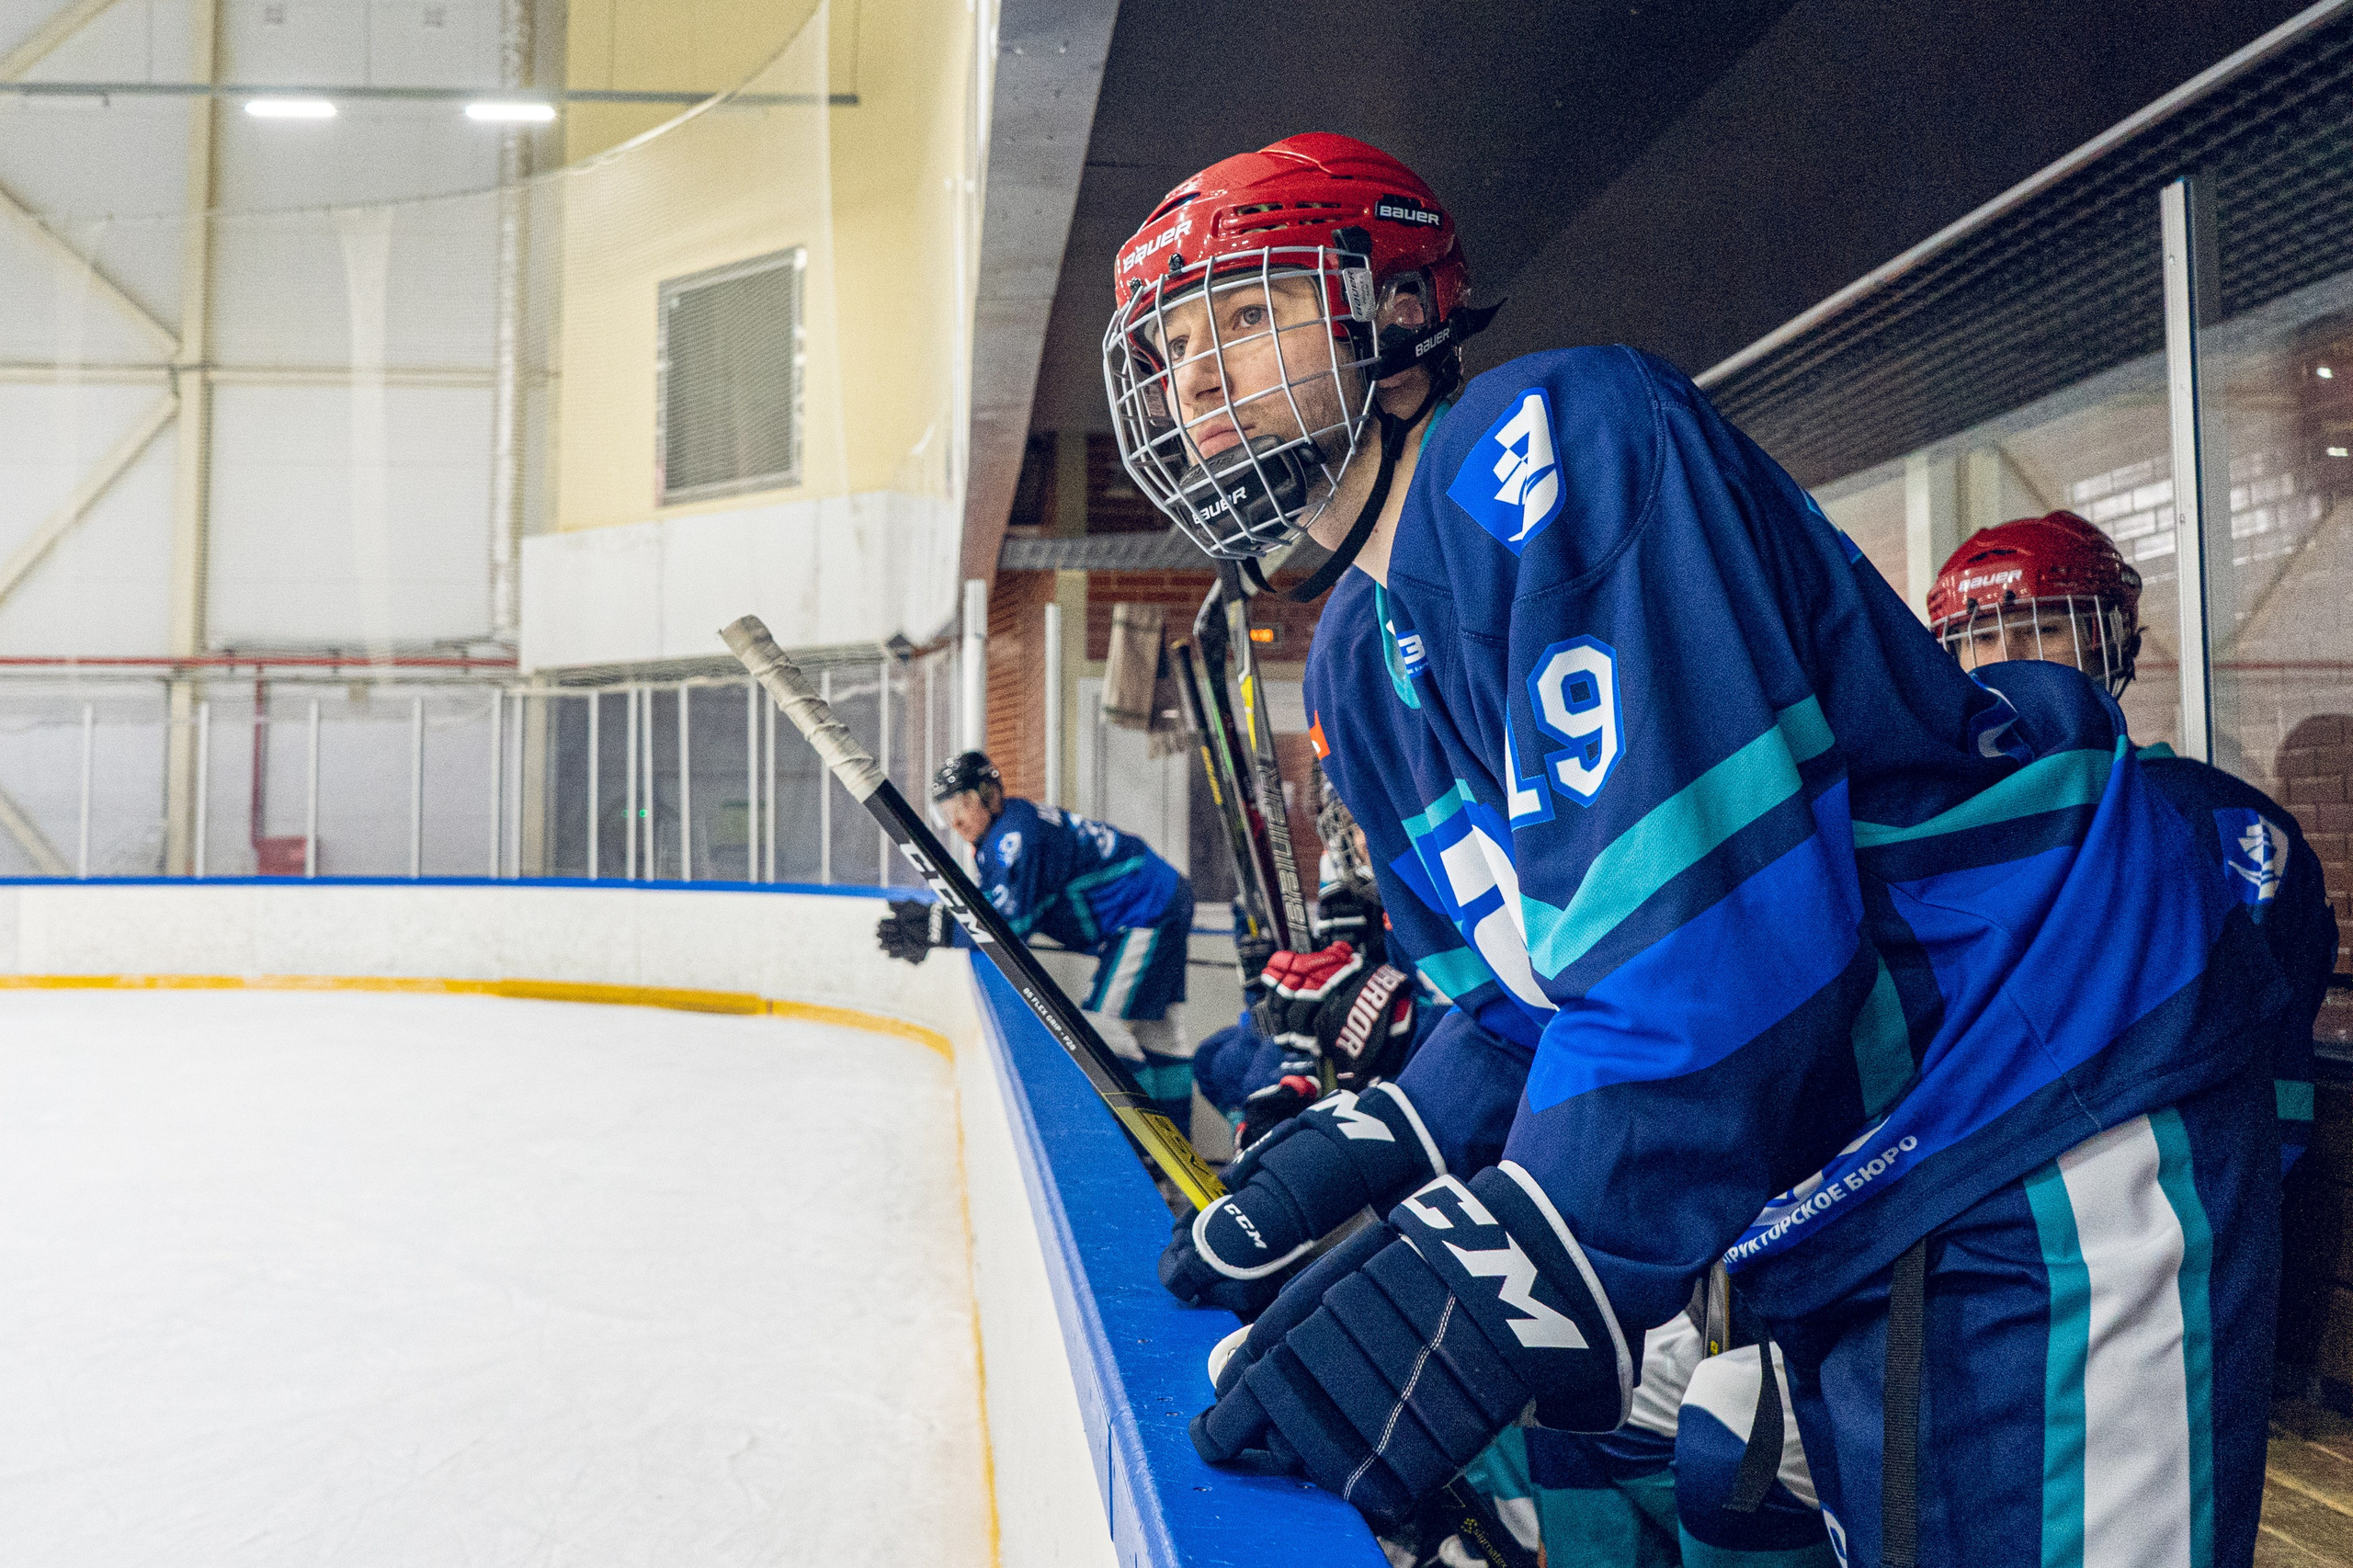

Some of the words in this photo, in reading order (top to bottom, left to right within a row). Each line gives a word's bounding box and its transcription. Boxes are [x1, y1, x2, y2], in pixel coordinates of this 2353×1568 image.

[1380, 205, 1440, 226] BAUER
[1122, 220, 1192, 274] BAUER
[1415, 327, 1450, 358] BAUER
[1958, 570, 2022, 593] BAUER
[900, 839, 995, 943] CCM
[1030, 996, 1048, 1017] FLEX
[1045, 1015, 1062, 1031] GRIP
[1843, 1135, 1918, 1191] БЮРО
[1223, 1202, 1268, 1249] CCM
